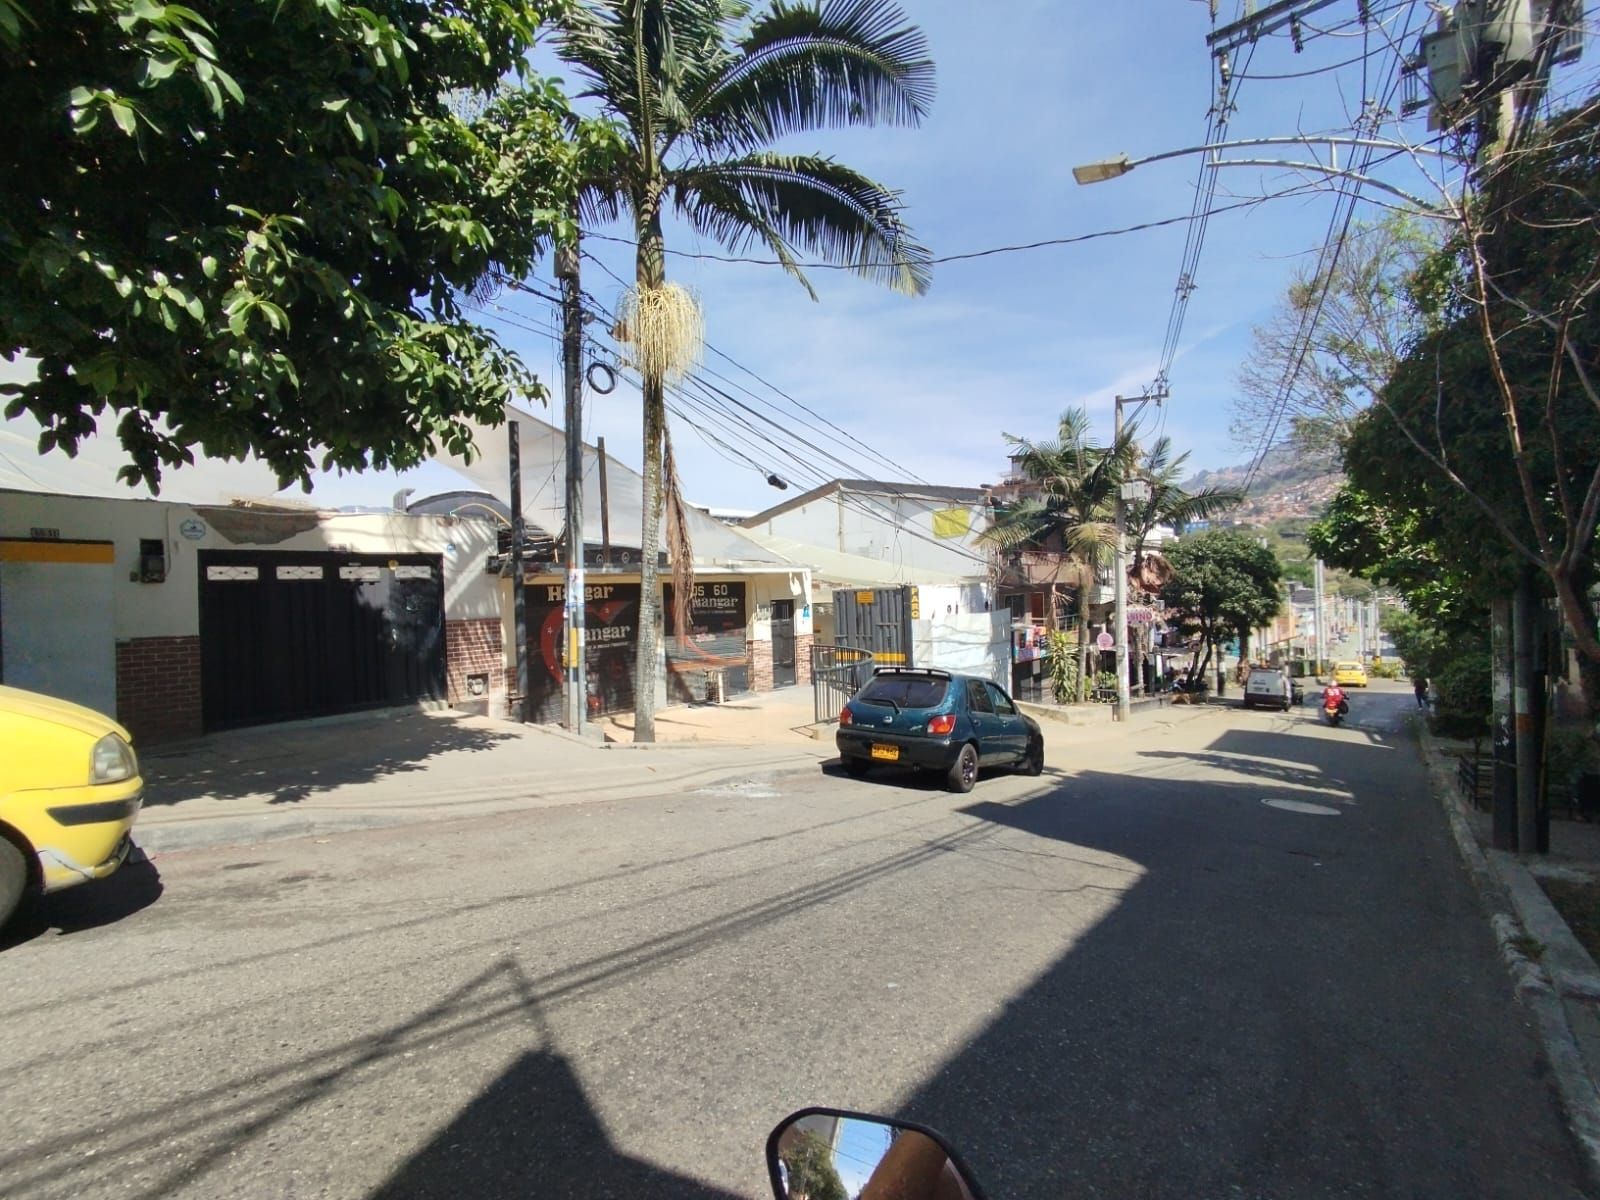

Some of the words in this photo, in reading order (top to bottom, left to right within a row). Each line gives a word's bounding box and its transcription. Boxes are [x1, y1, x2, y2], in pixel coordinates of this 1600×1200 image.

[547, 585, 614, 601] Hgar
[713, 584, 728, 596] 60
[583, 625, 631, 641] angar
